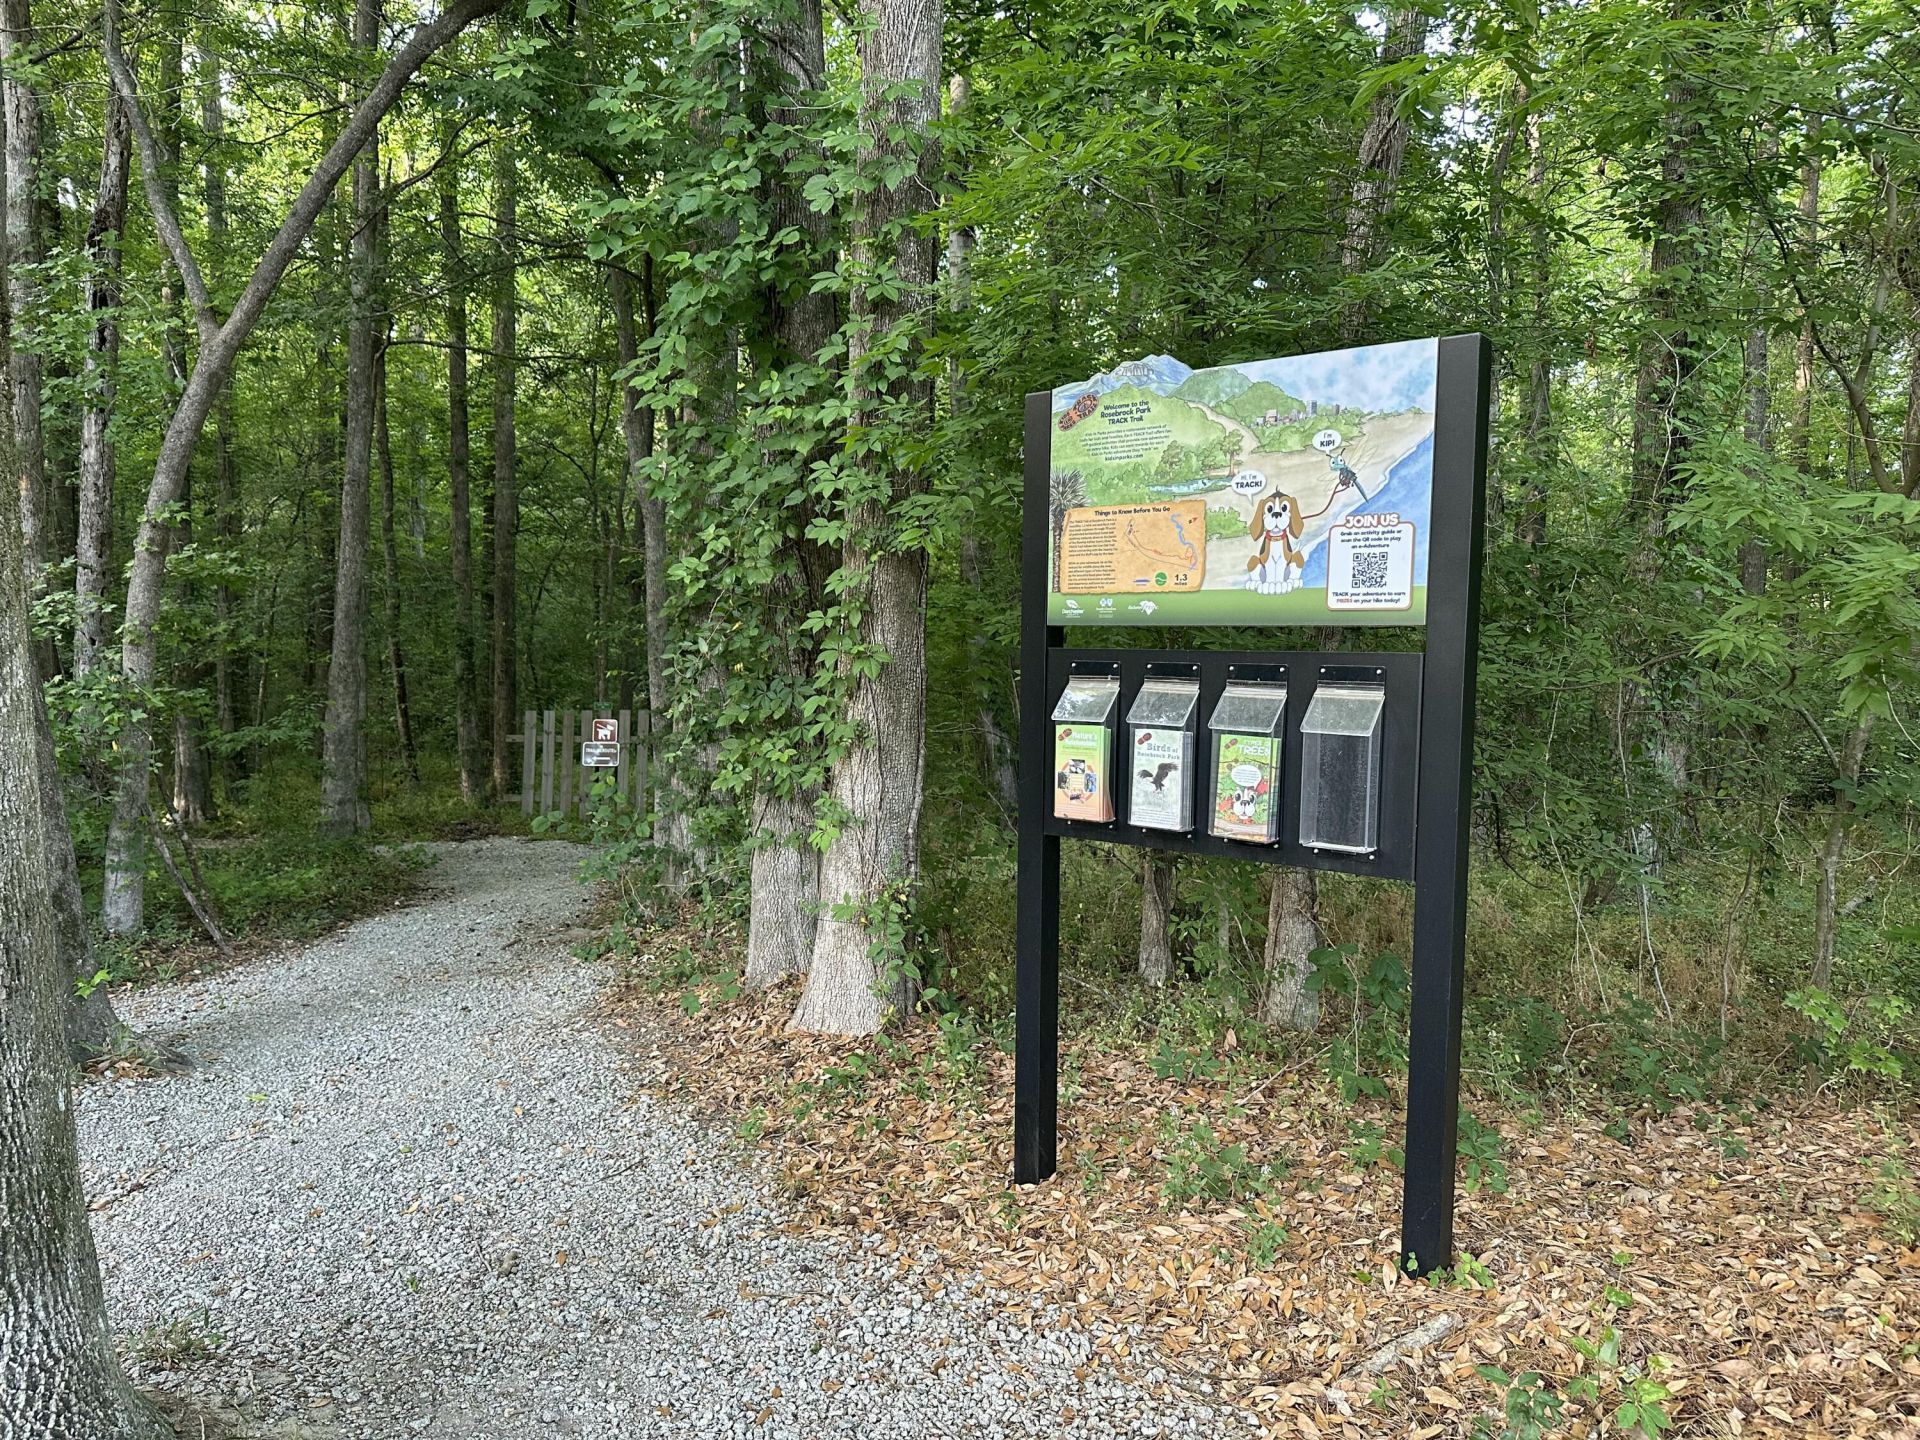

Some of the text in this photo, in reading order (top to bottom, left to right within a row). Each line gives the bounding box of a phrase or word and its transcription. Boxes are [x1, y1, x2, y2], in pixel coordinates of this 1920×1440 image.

[1101, 409, 1134, 418] Rosebrock
[1345, 513, 1399, 527] JOIN US
[1147, 743, 1171, 752] Birds
